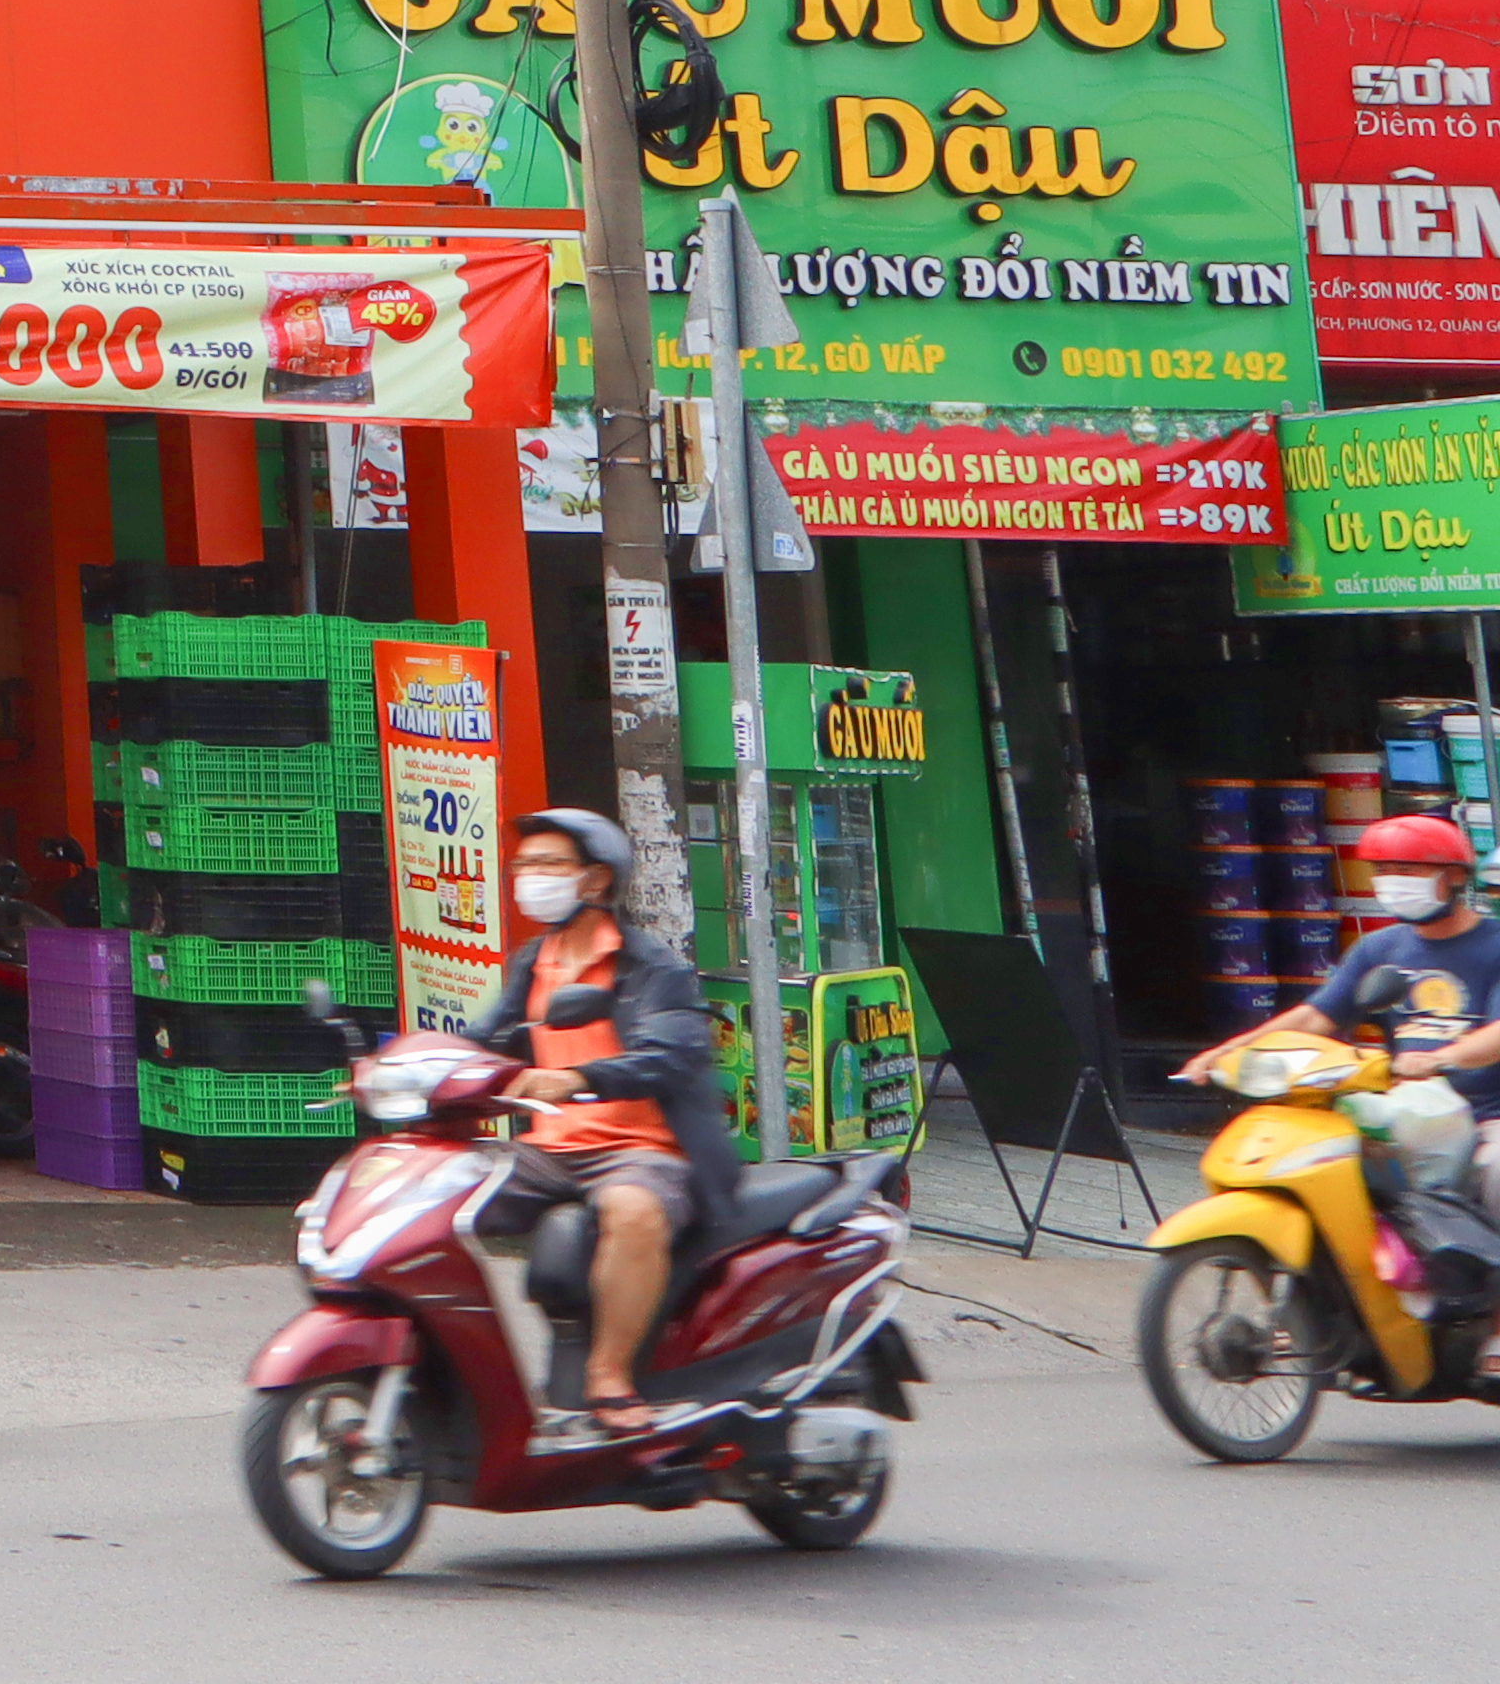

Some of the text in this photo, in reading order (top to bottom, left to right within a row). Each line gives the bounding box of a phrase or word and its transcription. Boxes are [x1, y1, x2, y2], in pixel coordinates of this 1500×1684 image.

[1352, 58, 1491, 105] SƠN
[1444, 112, 1478, 137] tô
[835, 88, 1138, 222] Dậu
[65, 258, 235, 279] XÚC XÍCH COCKTAIL
[961, 231, 1053, 300] ĐỔI
[1063, 235, 1193, 303] NIỀM
[1206, 262, 1292, 304] TIN
[62, 277, 245, 299] XÔNG KHÓI CP (250G)
[367, 284, 411, 302] GIẢM
[1360, 280, 1393, 299] SƠN
[1396, 279, 1443, 301] NƯỚC
[1455, 282, 1488, 301] SƠN
[361, 304, 425, 326] 45%
[168, 342, 253, 359] 41.500
[824, 334, 871, 373] GÒ
[880, 333, 946, 375] VẤP
[1060, 346, 1143, 379] 0901
[1149, 347, 1216, 381] 032
[1222, 350, 1288, 382] 492
[175, 364, 248, 390] Đ/GÓI
[782, 448, 830, 481] GÀ
[835, 446, 858, 482] Ủ
[865, 442, 956, 484] MUỐI
[965, 450, 1038, 486] SIÊU
[1045, 456, 1142, 487] NGON
[1341, 427, 1380, 488] CÁC
[1382, 424, 1428, 485] MÓN
[1430, 418, 1464, 482] ĂN
[861, 491, 898, 527] GÀ
[901, 488, 918, 527] Ủ
[923, 487, 991, 529] MUỐI
[996, 499, 1064, 531] NGON
[1069, 495, 1100, 531] TÊ
[1103, 495, 1144, 531] TÁI
[1325, 498, 1472, 562] Út Dậu
[407, 672, 484, 708] ĐẶC QUYỀN
[445, 704, 493, 742] VIÊN
[423, 788, 484, 840] 20%
